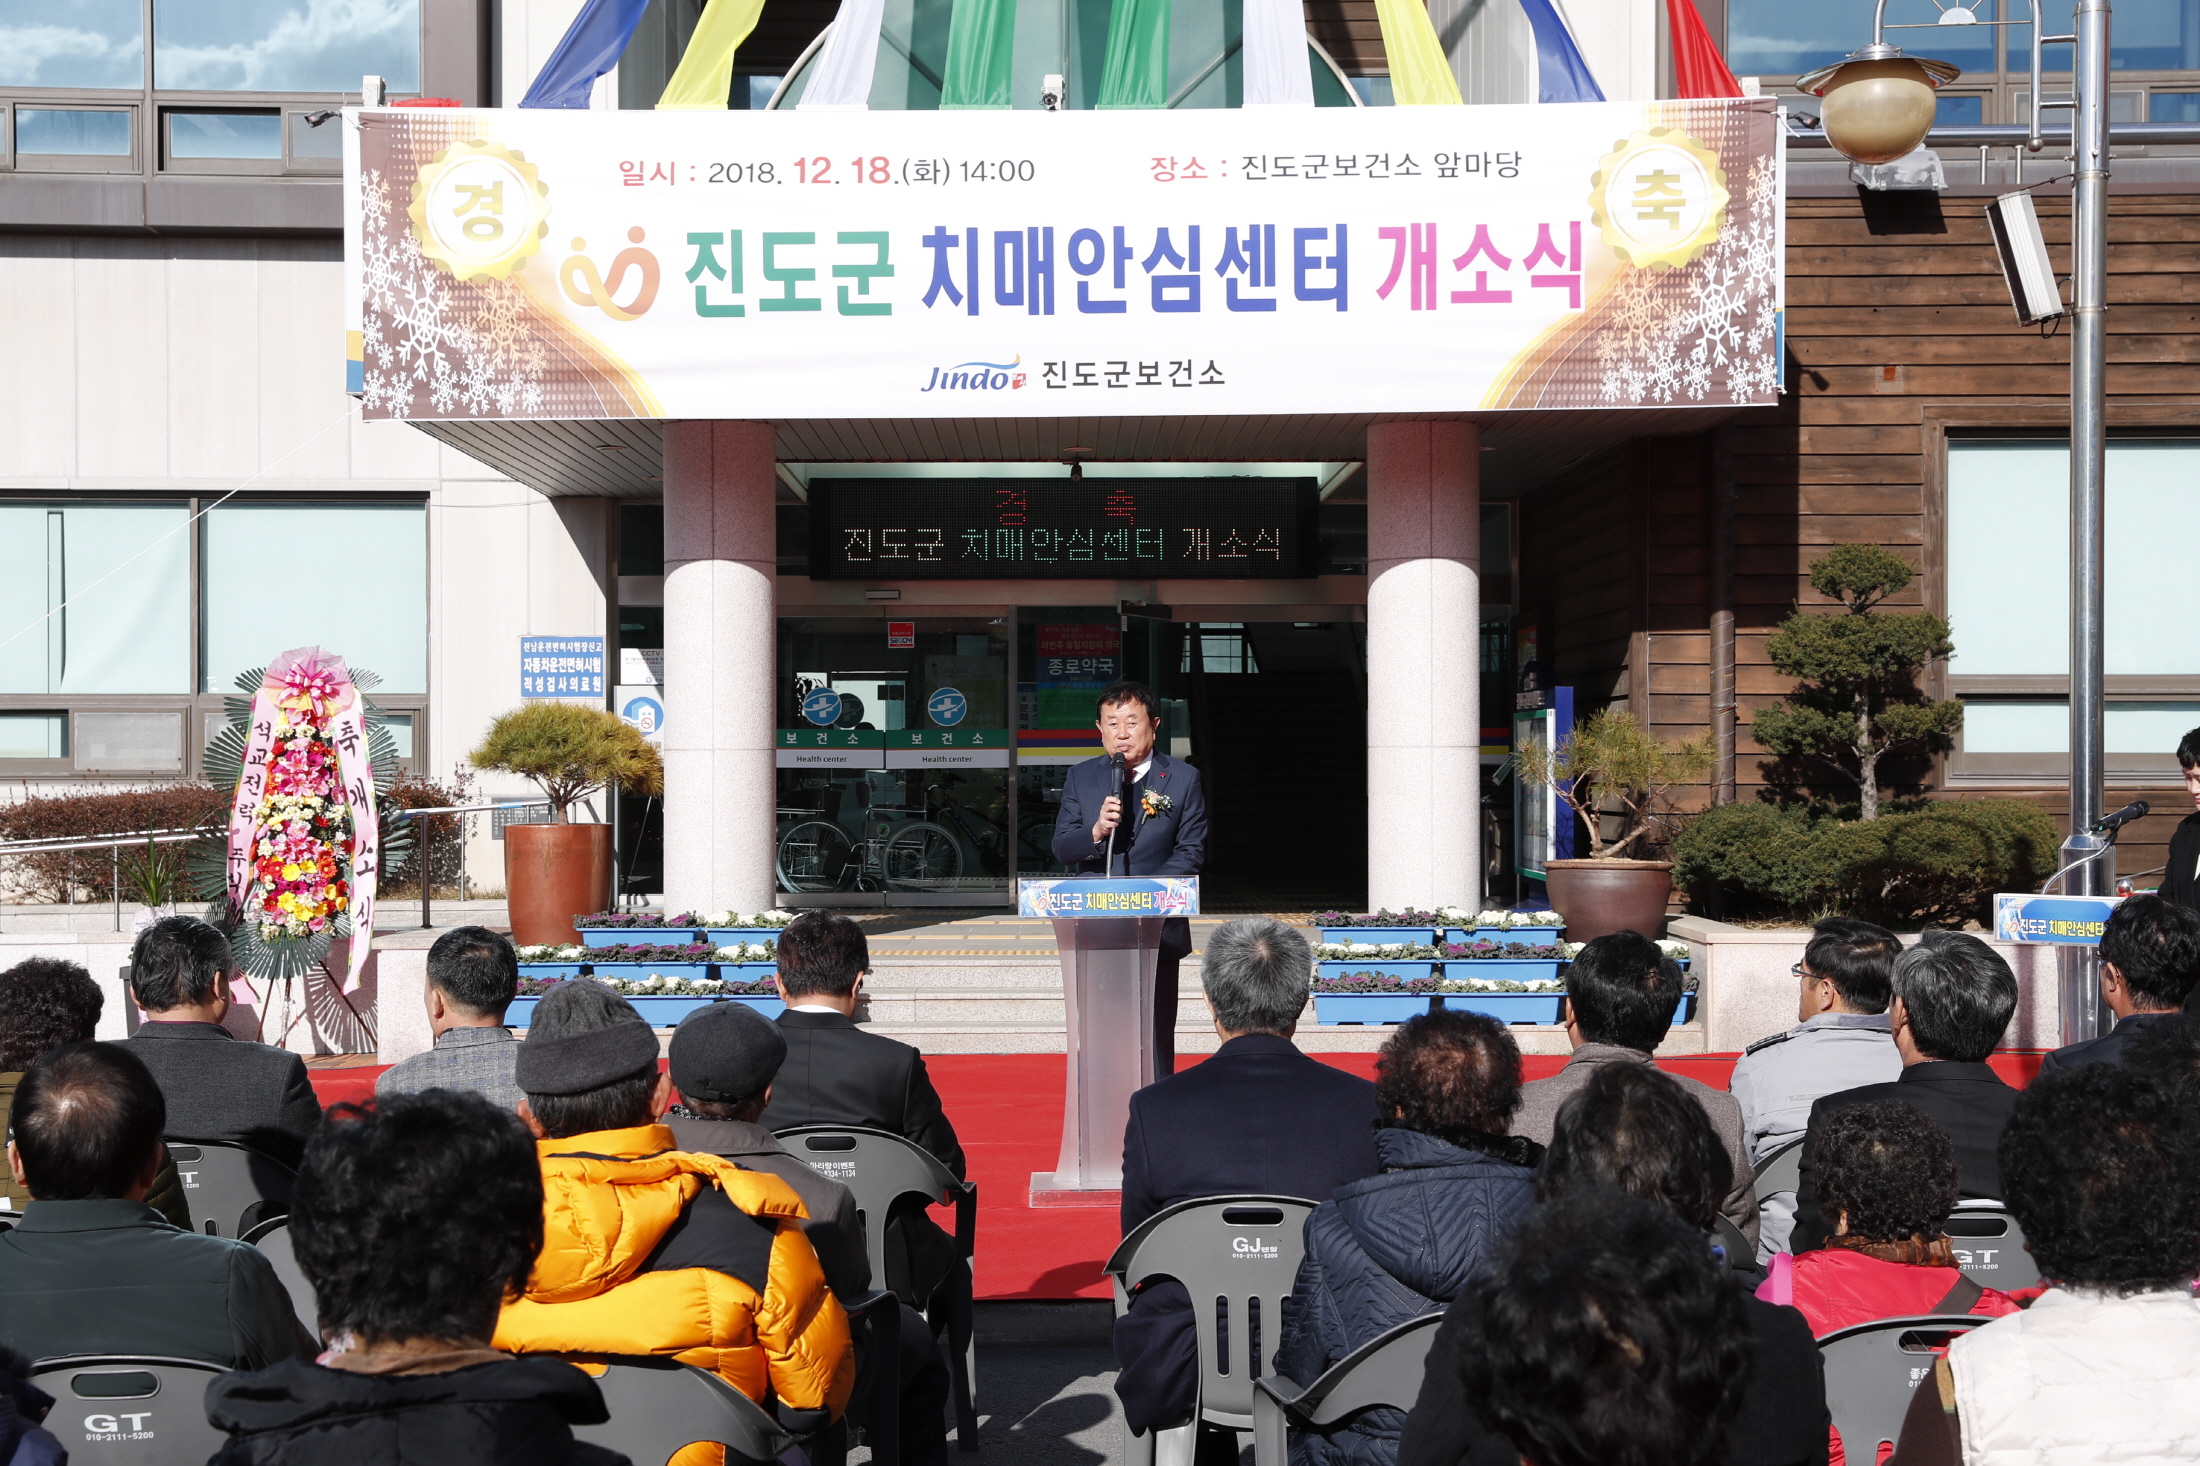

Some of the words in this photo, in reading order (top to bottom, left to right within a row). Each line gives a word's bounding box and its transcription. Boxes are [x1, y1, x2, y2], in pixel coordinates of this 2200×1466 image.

[619, 160, 676, 187] 일시
[708, 162, 782, 185] 2018.
[793, 156, 840, 185] 12.
[959, 160, 1035, 183] 14:00
[1150, 156, 1209, 183] 장소
[1241, 153, 1422, 181] 진도군보건소
[1433, 151, 1523, 179] 앞마당
[1632, 169, 1687, 230] 축
[452, 181, 504, 242] 경
[685, 229, 895, 318] 진도군
[921, 223, 1349, 317] 치매안심센터
[1375, 220, 1582, 312] 개소식
[920, 365, 1009, 393] Jindo
[1041, 359, 1226, 390] 진도군보건소
[844, 528, 945, 561] 진도군
[961, 528, 1164, 564] 치매안심센터
[1182, 528, 1281, 561] 개소식
[523, 657, 602, 674] 자동차운전면허시험
[1047, 658, 1114, 676] 종로약국
[796, 755, 823, 764] Health
[823, 756, 848, 764] center
[922, 755, 948, 764] Health
[948, 756, 973, 764] center
[238, 720, 273, 826] 석교전력
[1049, 892, 1083, 911] 진도군
[1085, 891, 1152, 911] 치매안심센터
[1153, 890, 1188, 910] 개소식
[2019, 918, 2047, 935] 진도군
[2048, 919, 2105, 938] 치매안심센터
[1951, 1249, 1999, 1264] GT
[83, 1411, 152, 1433] GT
[85, 1431, 155, 1441] 010-2111-5200
